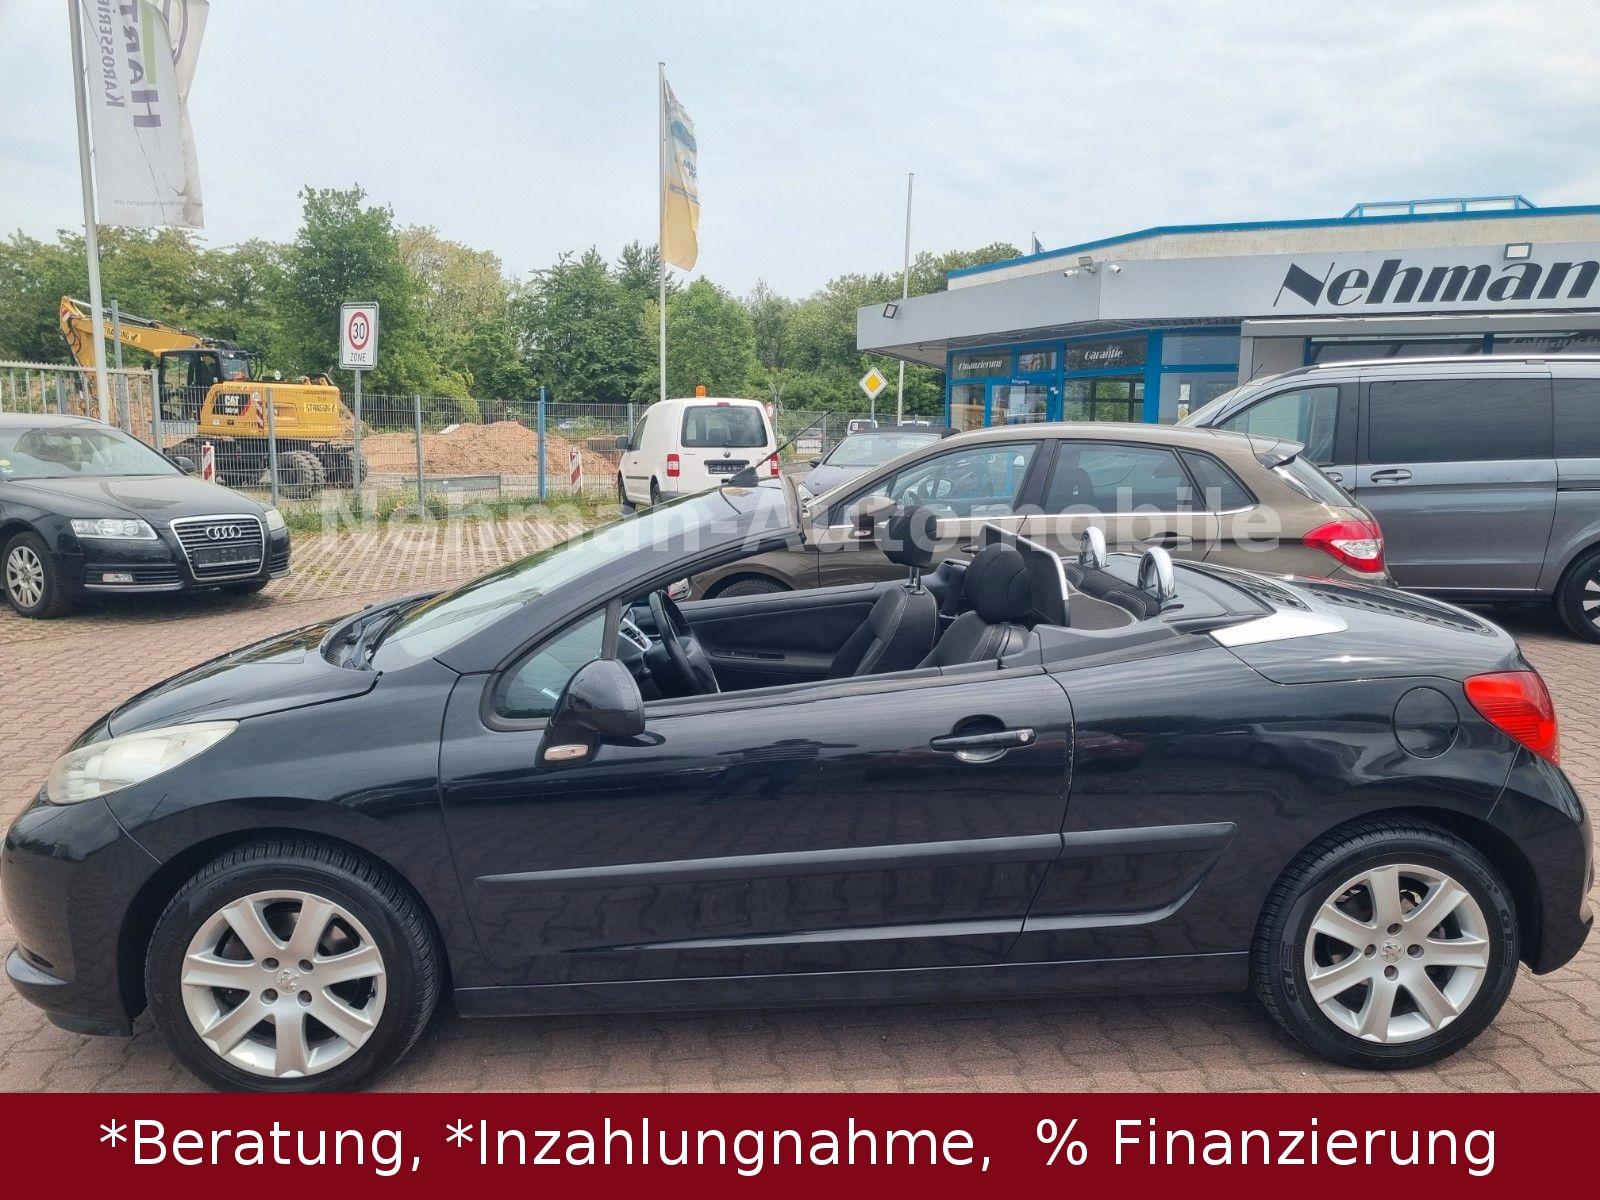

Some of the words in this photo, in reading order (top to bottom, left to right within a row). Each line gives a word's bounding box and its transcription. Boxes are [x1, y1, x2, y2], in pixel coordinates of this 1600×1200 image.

[352, 322, 365, 340] 30
[350, 352, 366, 362] ZONE
[224, 395, 240, 406] CAT
